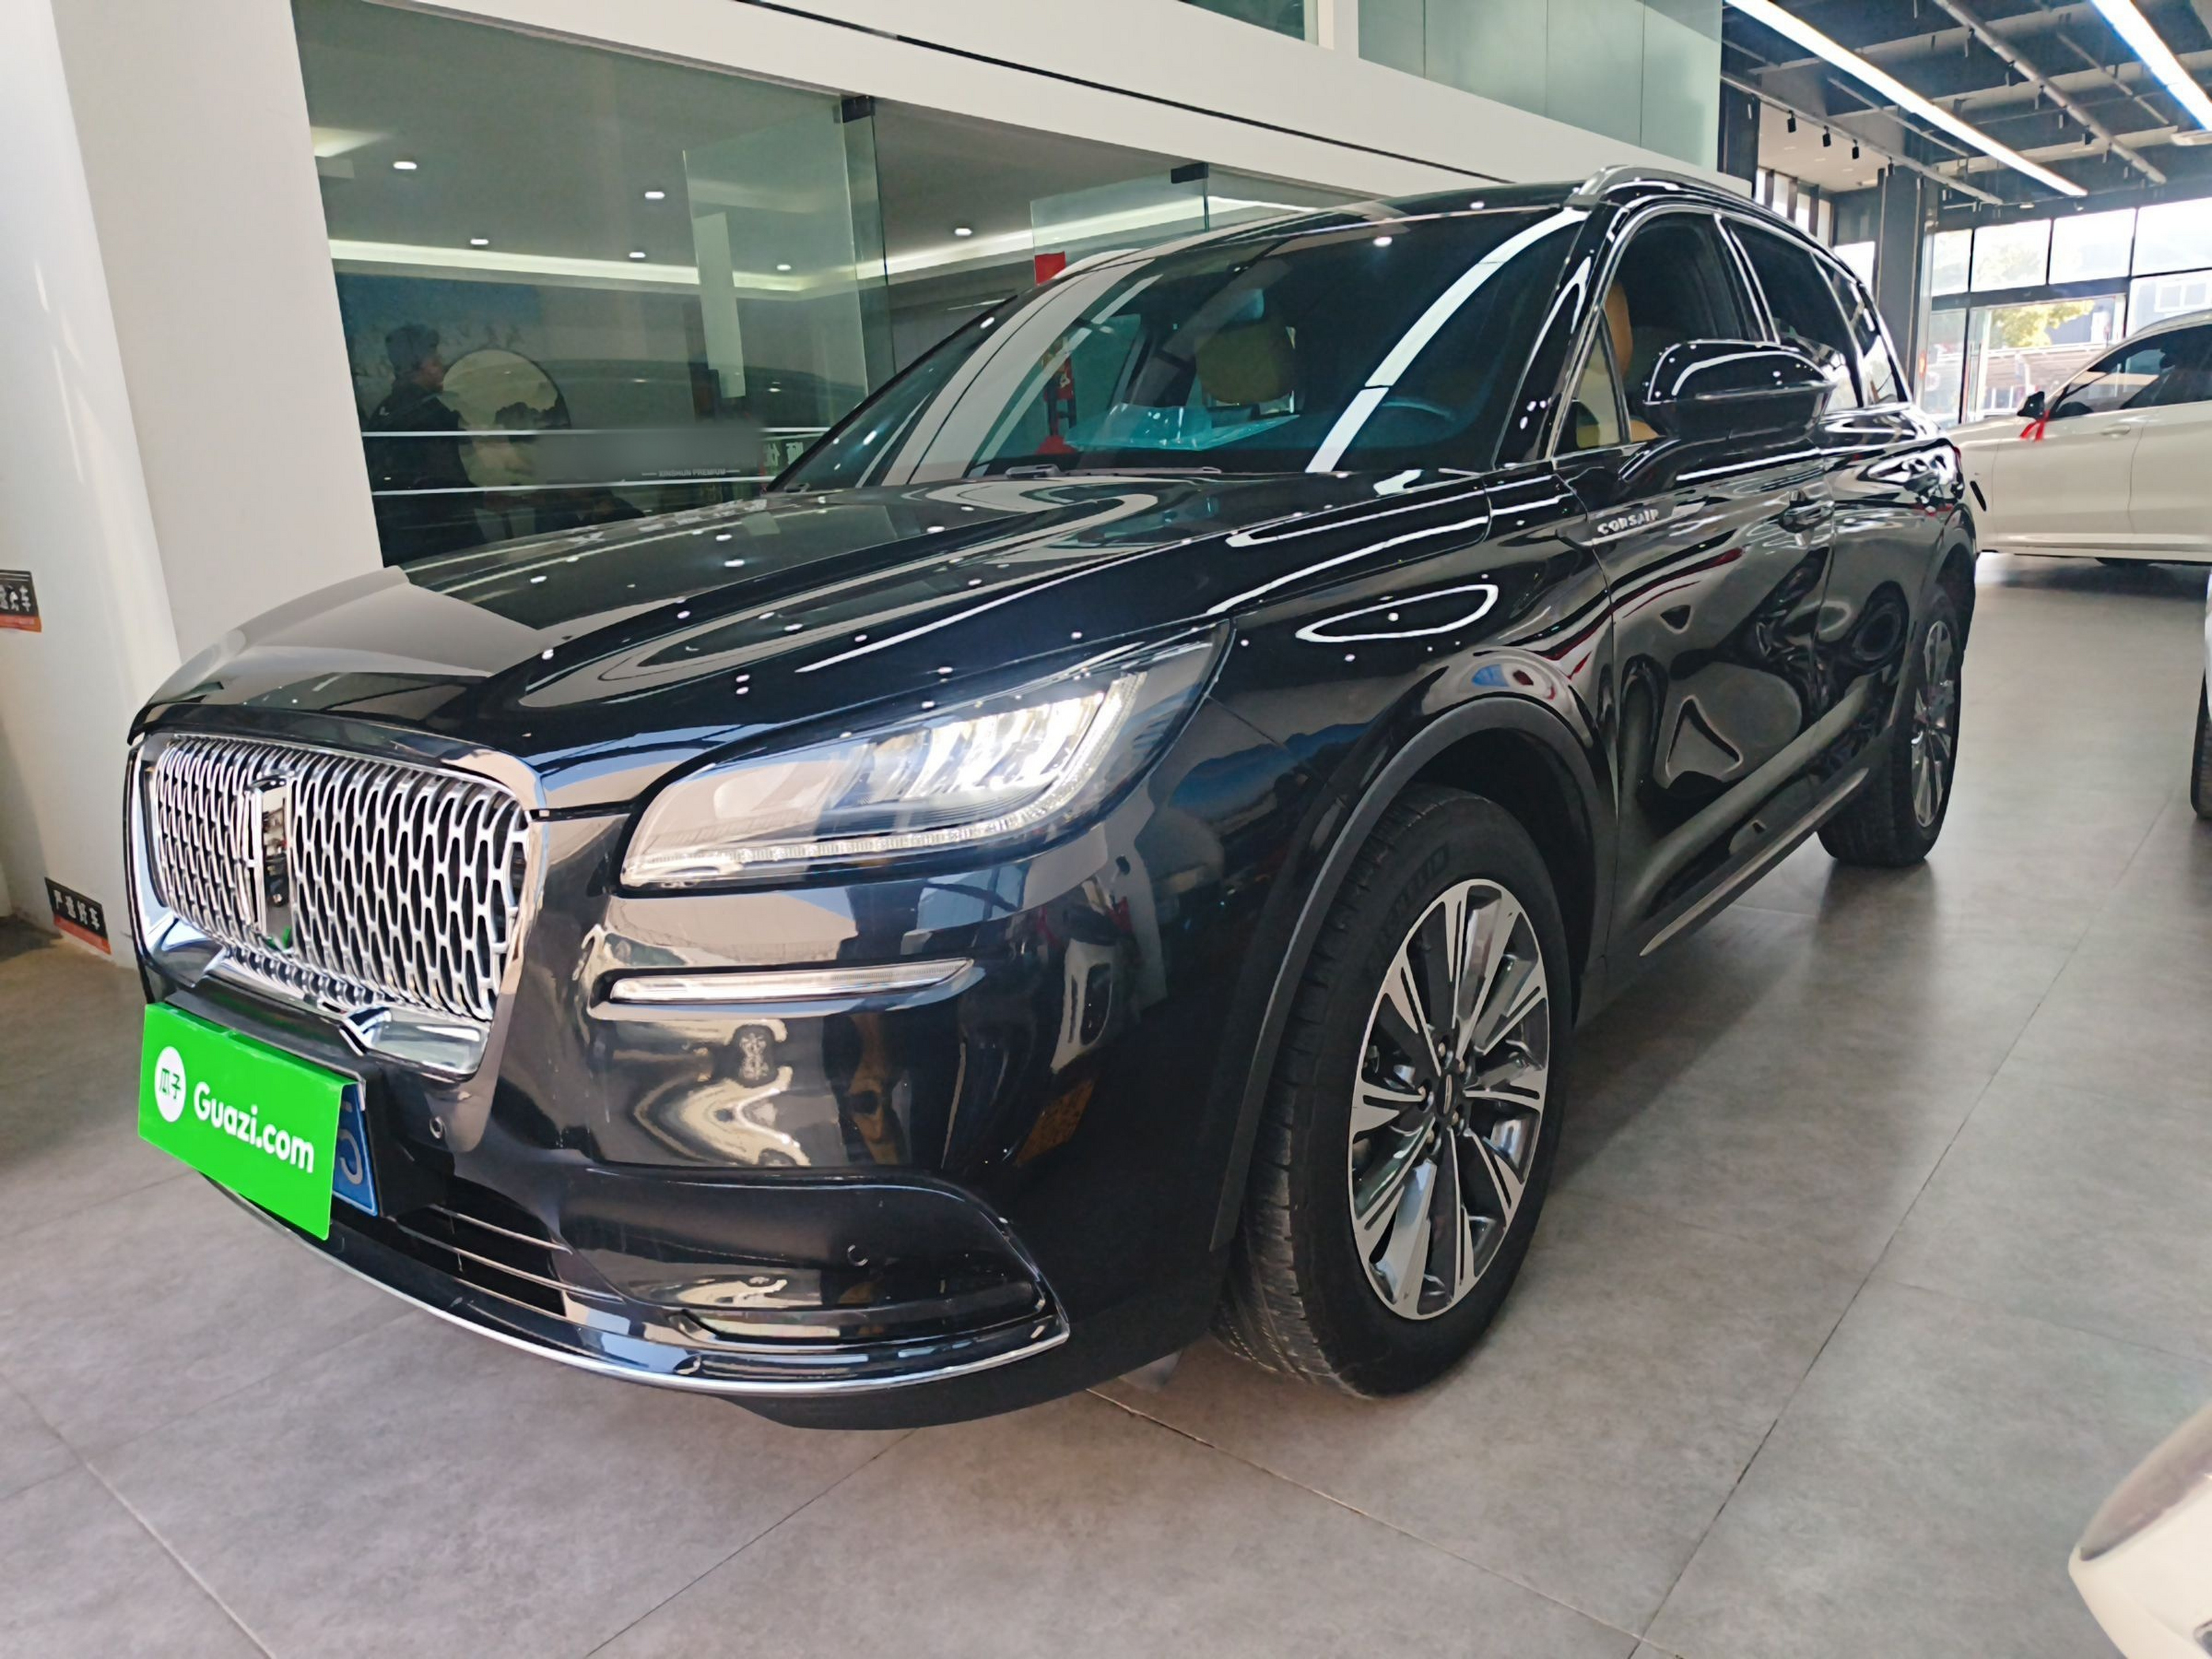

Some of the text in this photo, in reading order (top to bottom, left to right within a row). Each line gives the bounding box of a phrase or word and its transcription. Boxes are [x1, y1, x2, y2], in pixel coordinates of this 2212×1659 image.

[1597, 509, 1659, 534] CORSAIR
[160, 1068, 181, 1099] 瓜子
[194, 1081, 314, 1173] Guazi.com
